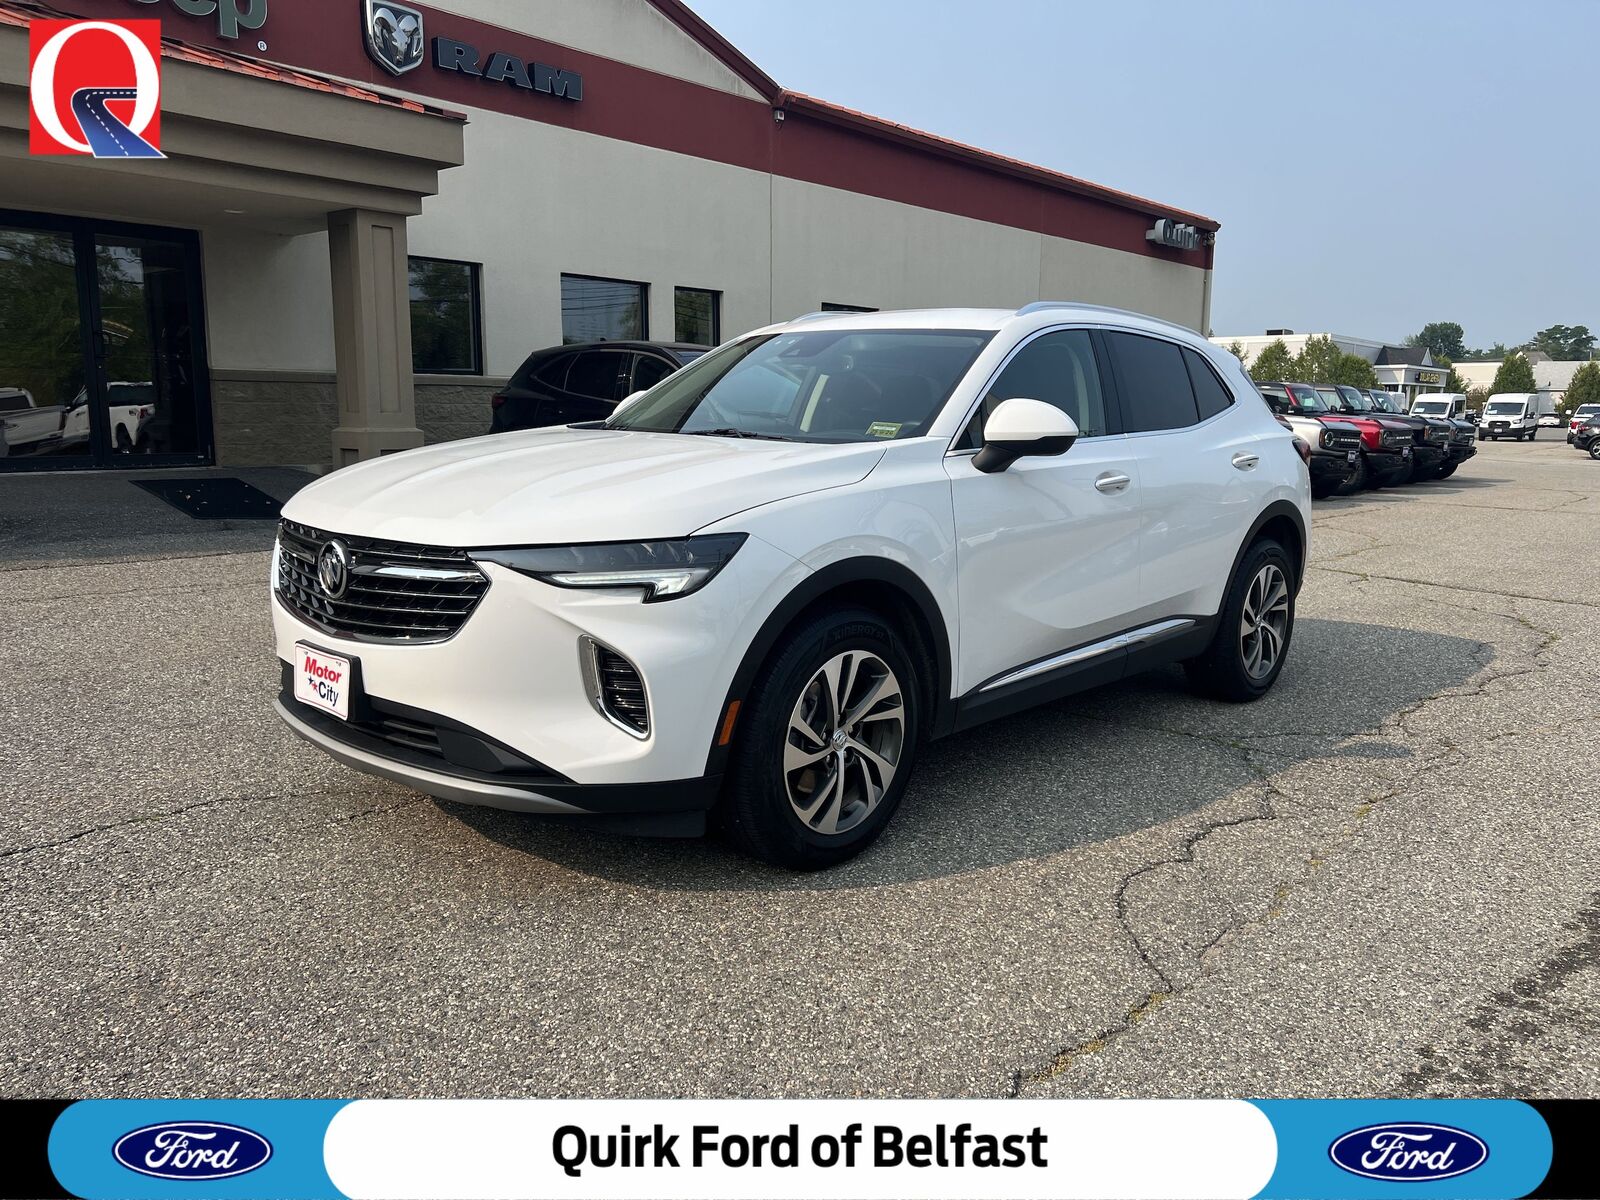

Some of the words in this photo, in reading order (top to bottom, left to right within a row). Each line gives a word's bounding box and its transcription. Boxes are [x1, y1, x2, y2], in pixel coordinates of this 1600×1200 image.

[432, 36, 583, 101] RAM
[304, 656, 341, 683] Motor
[318, 681, 339, 706] City
